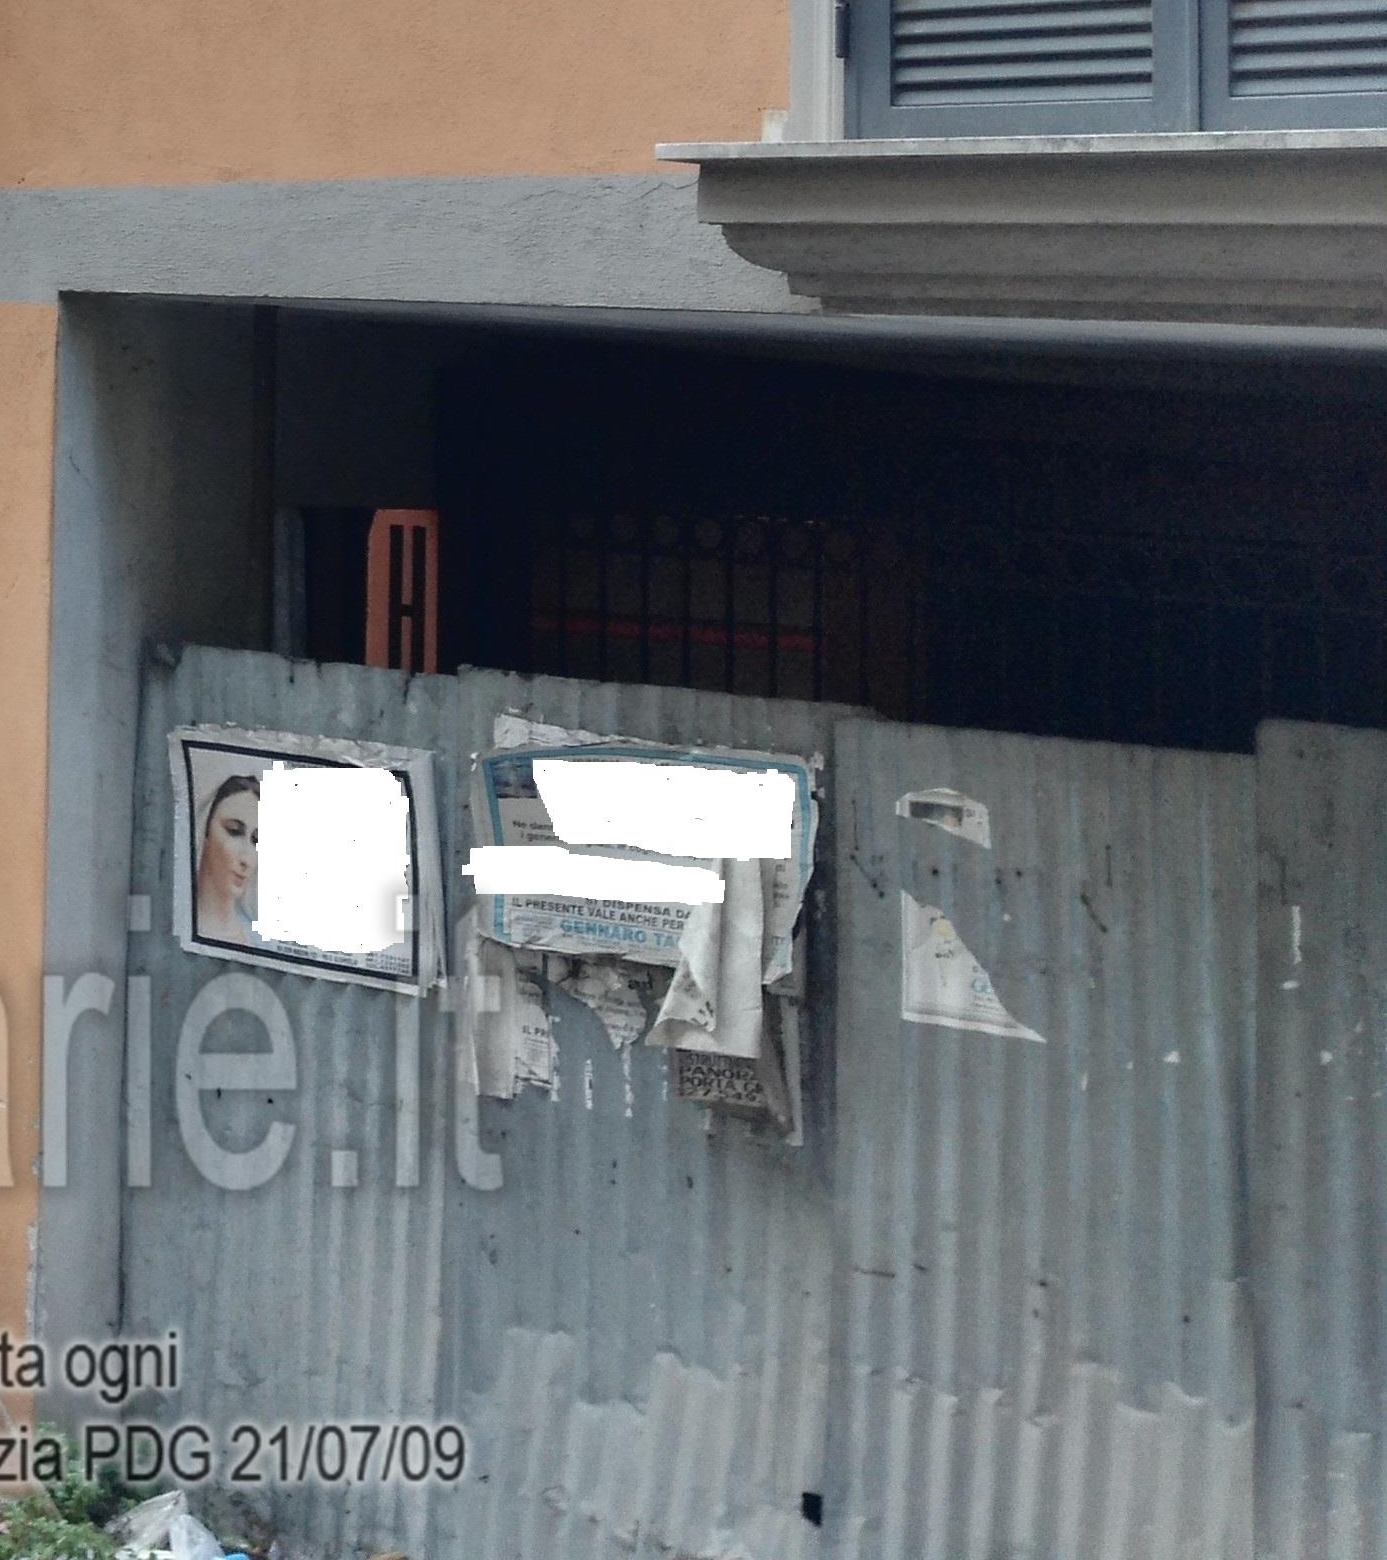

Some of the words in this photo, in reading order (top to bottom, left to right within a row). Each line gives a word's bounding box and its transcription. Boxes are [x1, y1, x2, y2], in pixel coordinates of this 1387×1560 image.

[512, 897, 523, 908] IL
[526, 899, 584, 916] PRESENTE
[588, 907, 616, 921] VALE
[619, 912, 658, 928] ANCHE
[662, 918, 685, 931] PER
[602, 900, 671, 917] DISPENSA
[560, 919, 647, 944] GENNARO
